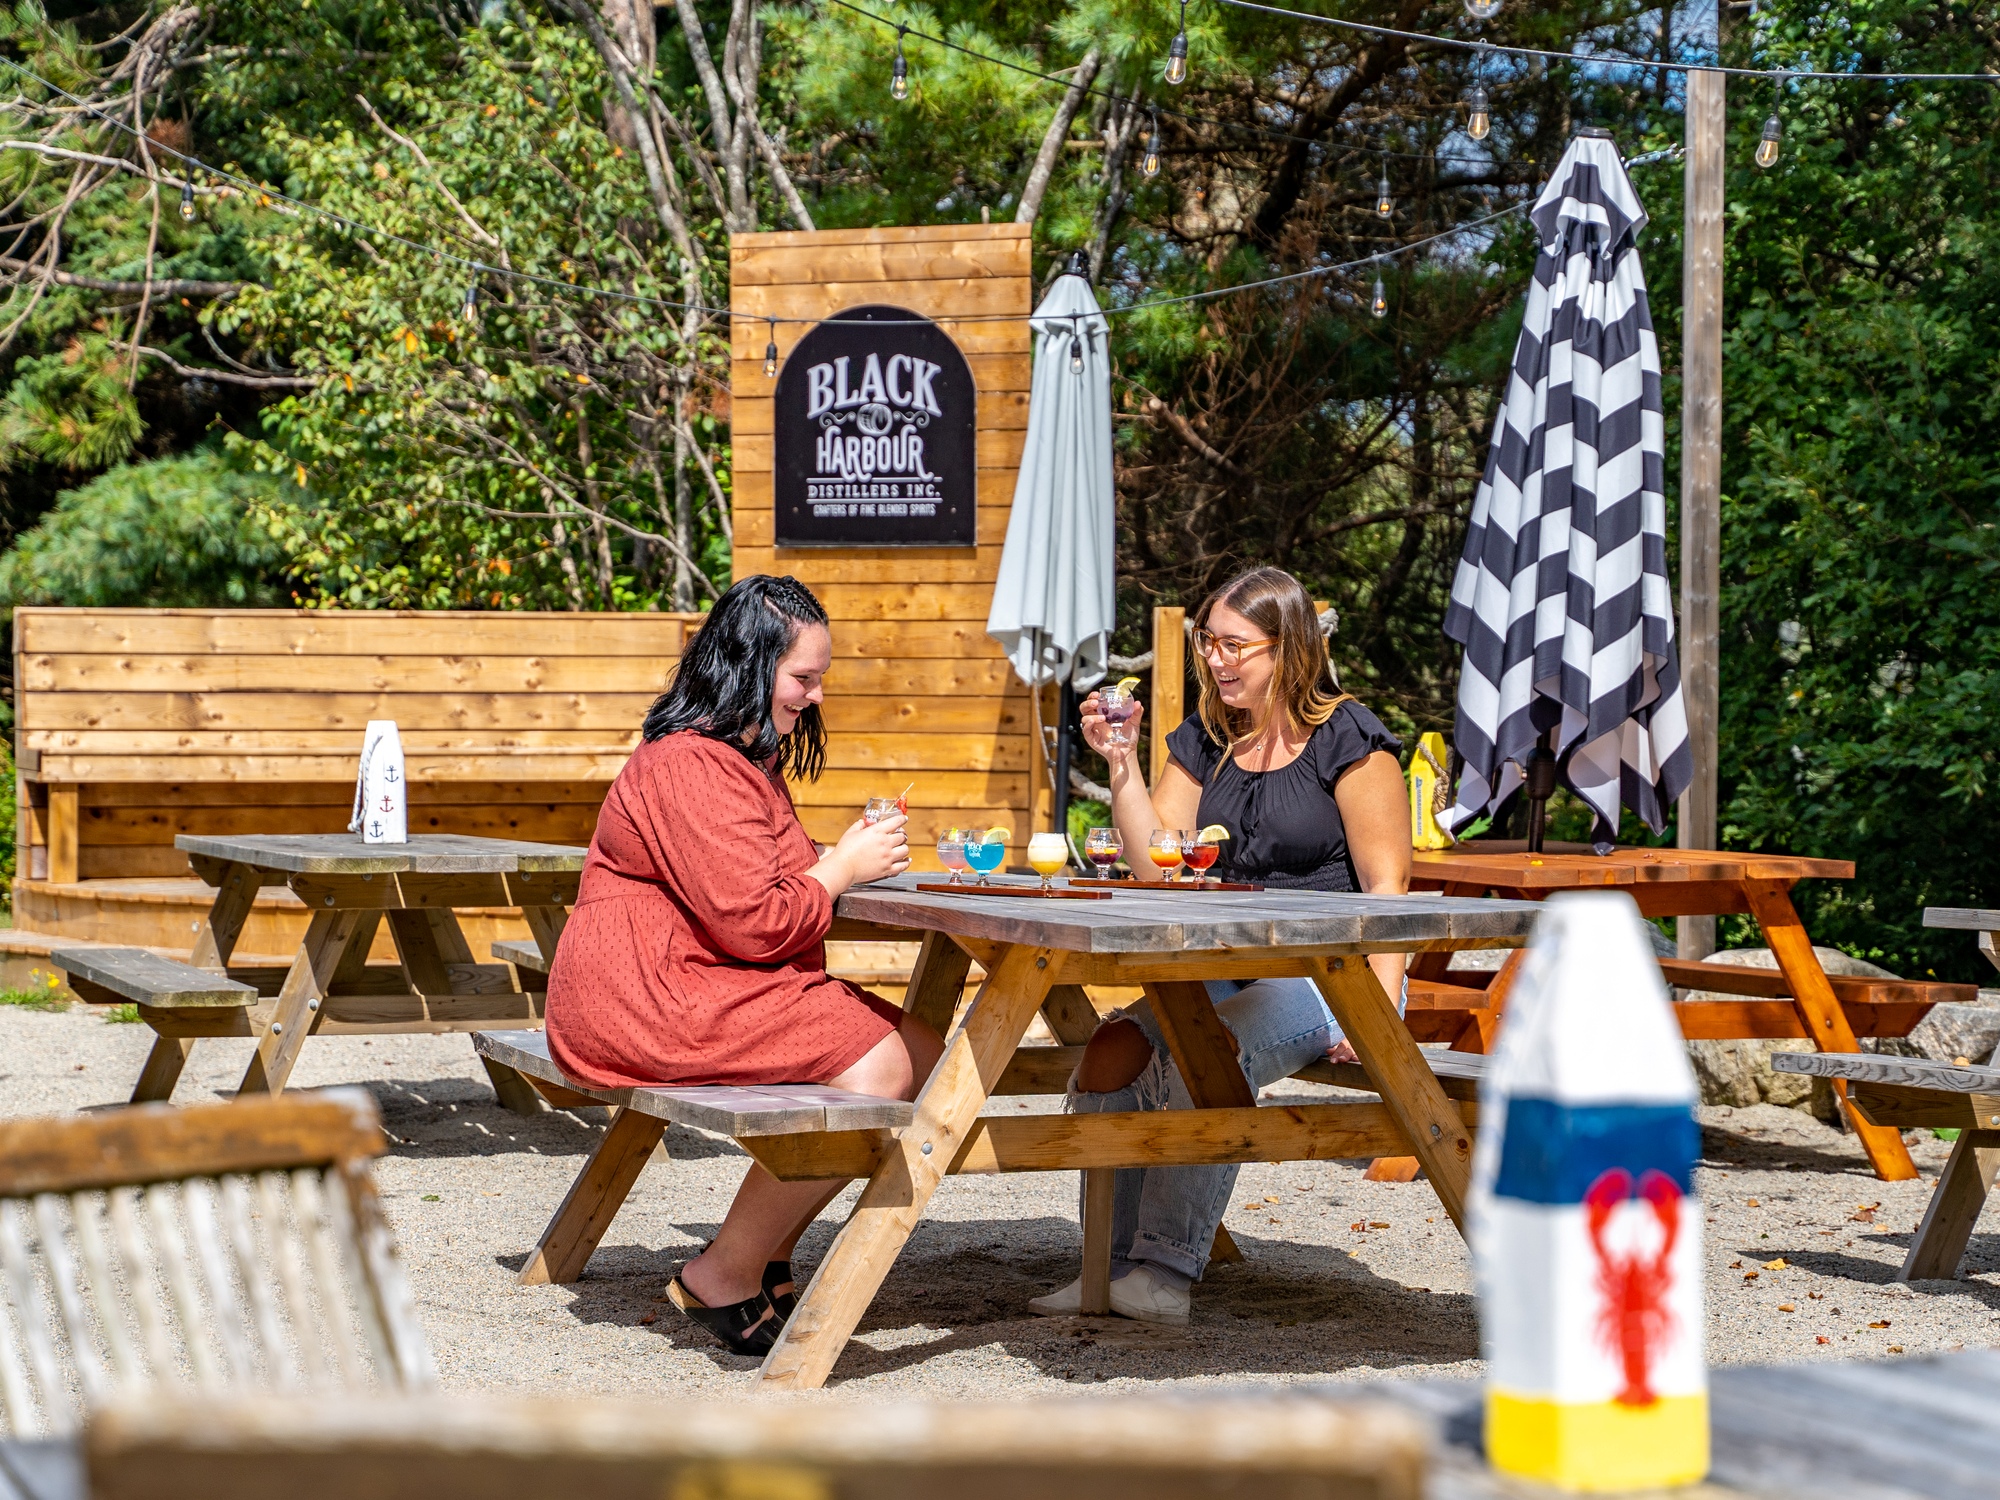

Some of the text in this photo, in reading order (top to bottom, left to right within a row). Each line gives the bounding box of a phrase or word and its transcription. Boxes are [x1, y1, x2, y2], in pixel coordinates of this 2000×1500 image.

[806, 352, 942, 420] BLACK
[815, 424, 934, 482] HARBOUR
[807, 483, 941, 499] DISTILLERS INC.
[813, 502, 936, 517] CRAFTERS OF FINE BLENDED SPIRITS
